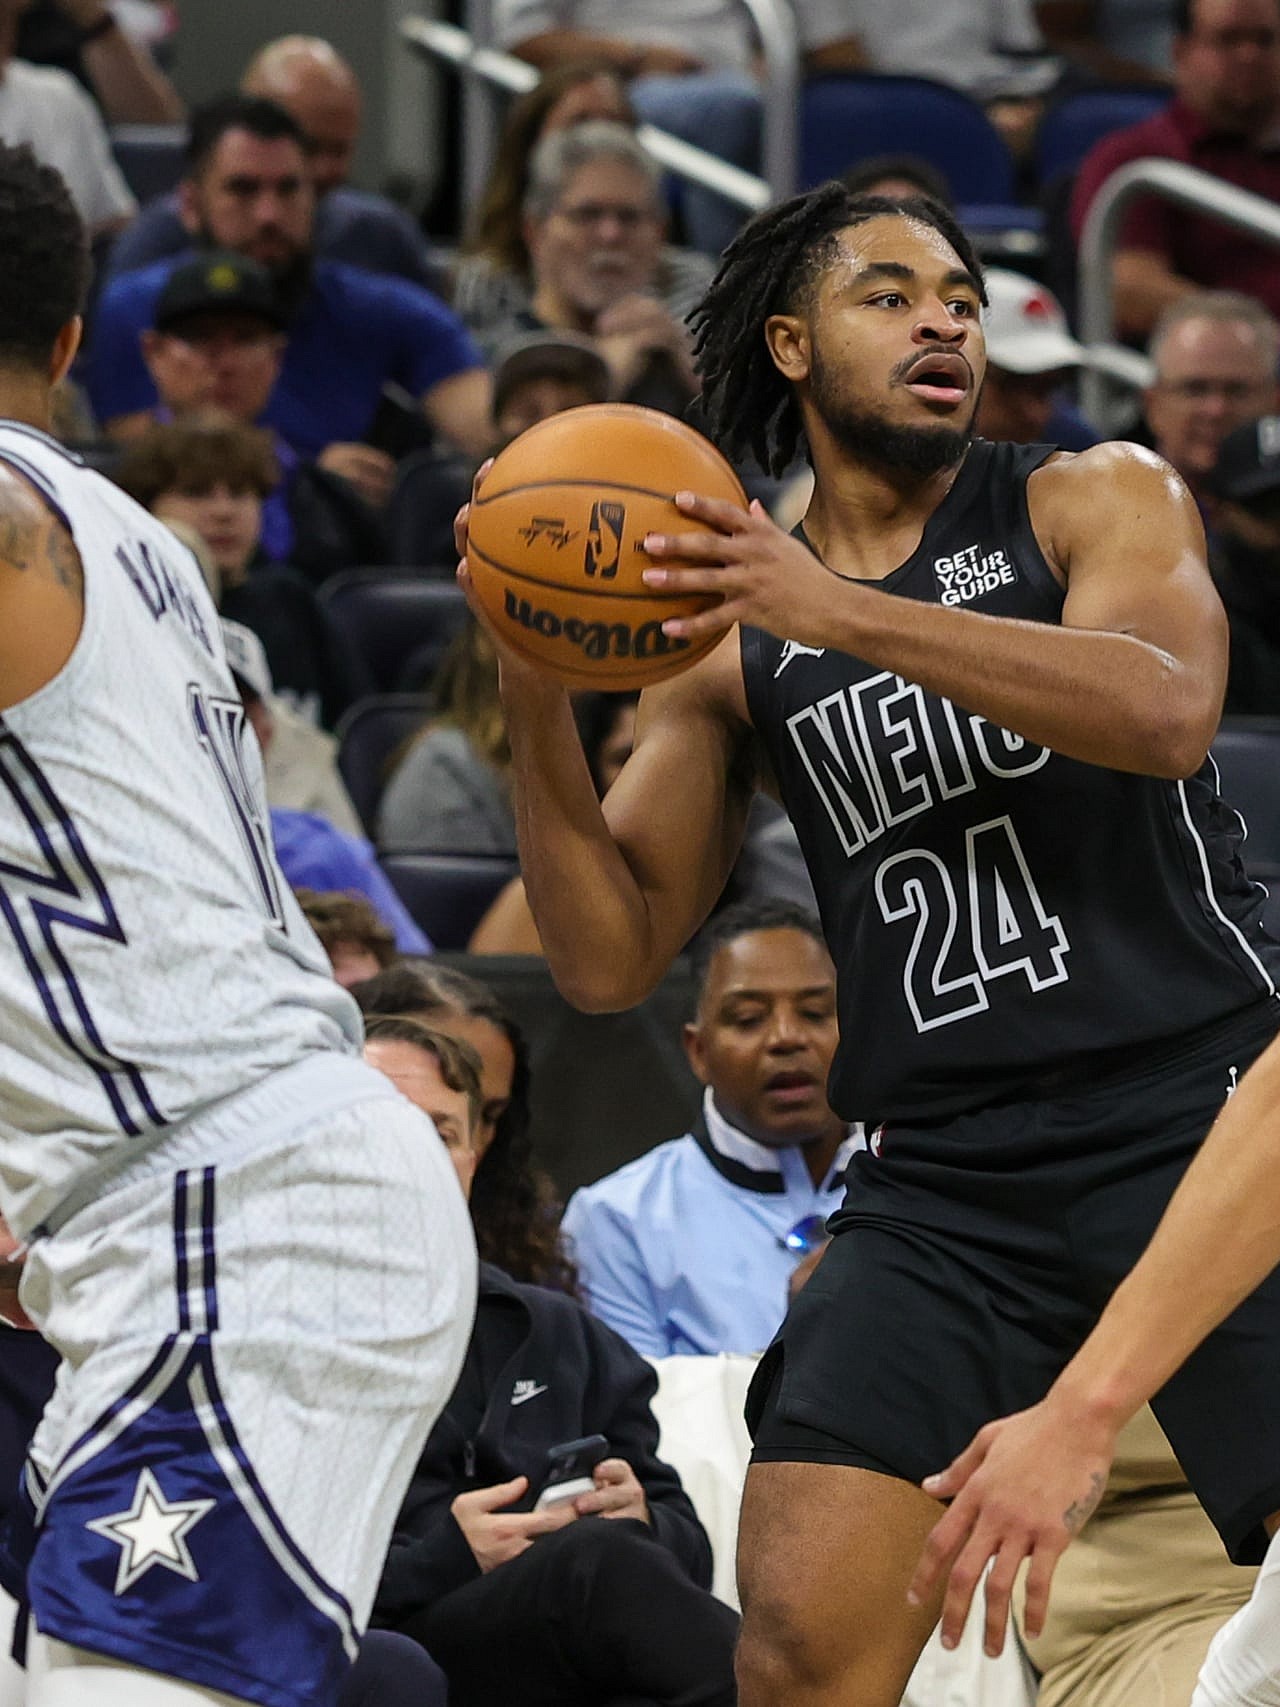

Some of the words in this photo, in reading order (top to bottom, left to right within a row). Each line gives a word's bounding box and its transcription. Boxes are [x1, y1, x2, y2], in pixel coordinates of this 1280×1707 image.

[934, 545, 978, 575] GET
[937, 551, 1006, 590] YOUR
[941, 564, 1015, 606] GUIDE
[874, 814, 1071, 1034] 24
